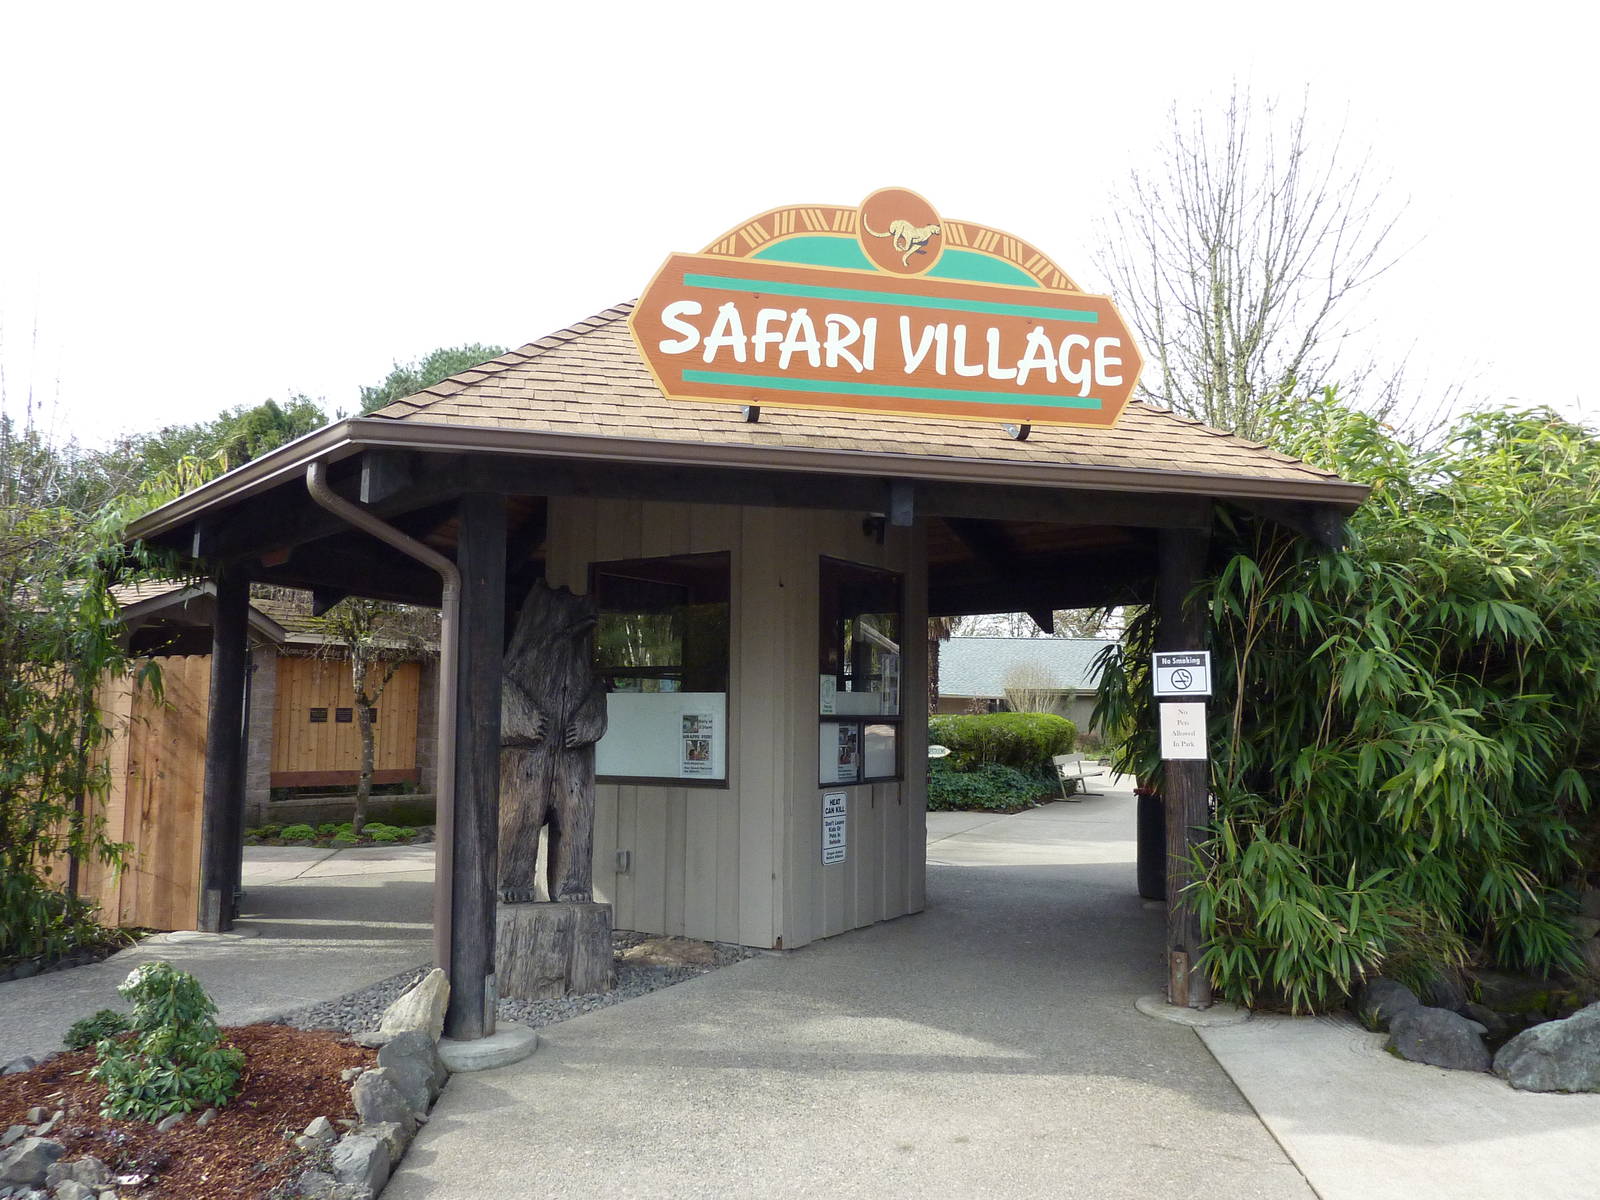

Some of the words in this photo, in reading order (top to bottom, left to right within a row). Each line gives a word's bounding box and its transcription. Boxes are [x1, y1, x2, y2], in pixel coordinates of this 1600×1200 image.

[658, 299, 878, 375] SAFARI
[899, 314, 1124, 398] VILLAGE
[1161, 657, 1171, 665] No
[1172, 656, 1201, 666] Smoking
[829, 798, 841, 806] HEAT
[825, 807, 834, 815] CAN
